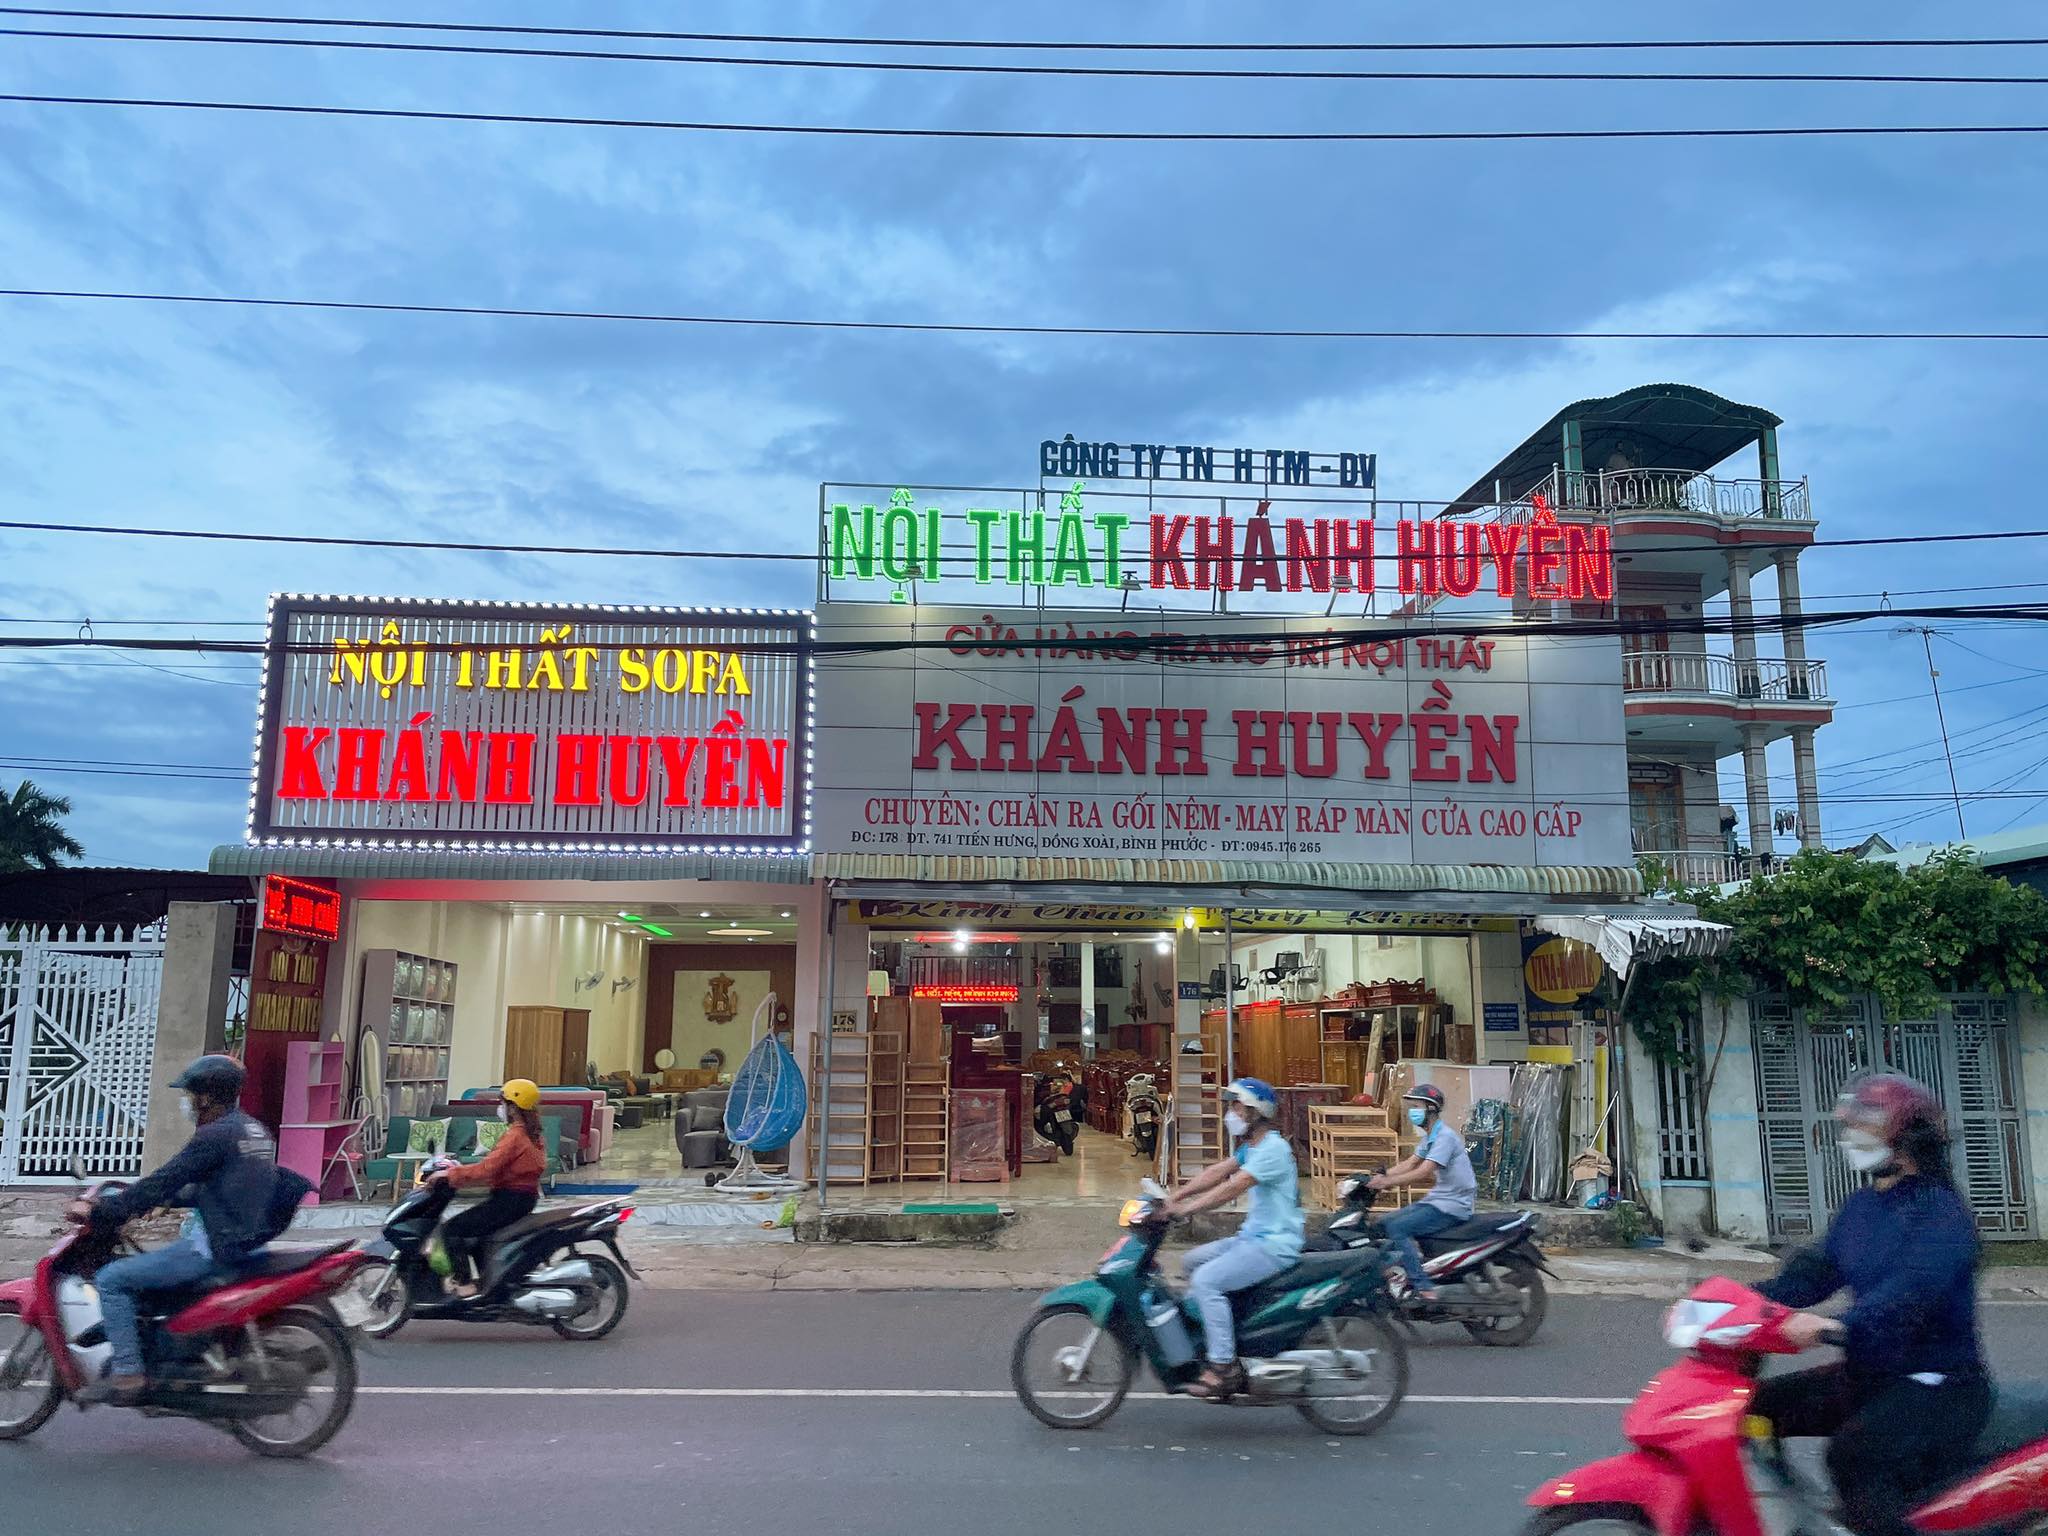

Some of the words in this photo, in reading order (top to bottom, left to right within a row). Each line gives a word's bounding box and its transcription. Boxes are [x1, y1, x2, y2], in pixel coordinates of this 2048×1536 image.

[1040, 434, 1119, 477] CÔNG
[1131, 444, 1166, 478] TY
[830, 486, 942, 604] NỘI
[966, 481, 1130, 588] THẤT
[1149, 501, 1375, 595] KHÁNH
[1396, 493, 1613, 601] HUYỀN
[329, 620, 429, 699] NỘI
[449, 623, 599, 692] THẤT
[619, 647, 752, 696] SOFA
[945, 614, 1026, 658] CỬA
[1034, 621, 1140, 661] HÀNG
[1416, 634, 1496, 671] THẤT
[912, 685, 1209, 776] KHÁNH
[1232, 678, 1520, 783] HUYỀN
[277, 711, 537, 805] KHÁNH
[553, 709, 789, 809] HUYỀN
[864, 790, 980, 827] CHUYÊN:
[987, 792, 1058, 829] CHĂN
[1067, 800, 1104, 829] RA
[1112, 792, 1156, 831] GỐI
[1295, 798, 1347, 834] RÁP
[1354, 799, 1410, 835] MÀN
[1421, 796, 1473, 836] CỬA
[1479, 808, 1527, 837] CAO
[1534, 800, 1583, 838] CẤP
[878, 832, 899, 845] 178
[933, 833, 953, 847] 741
[957, 829, 991, 848] TIẾN
[994, 834, 1038, 850] HƯNG,
[1162, 835, 1208, 851] PHƯỚC
[1182, 987, 1197, 996] 176
[833, 1014, 856, 1026] 178
